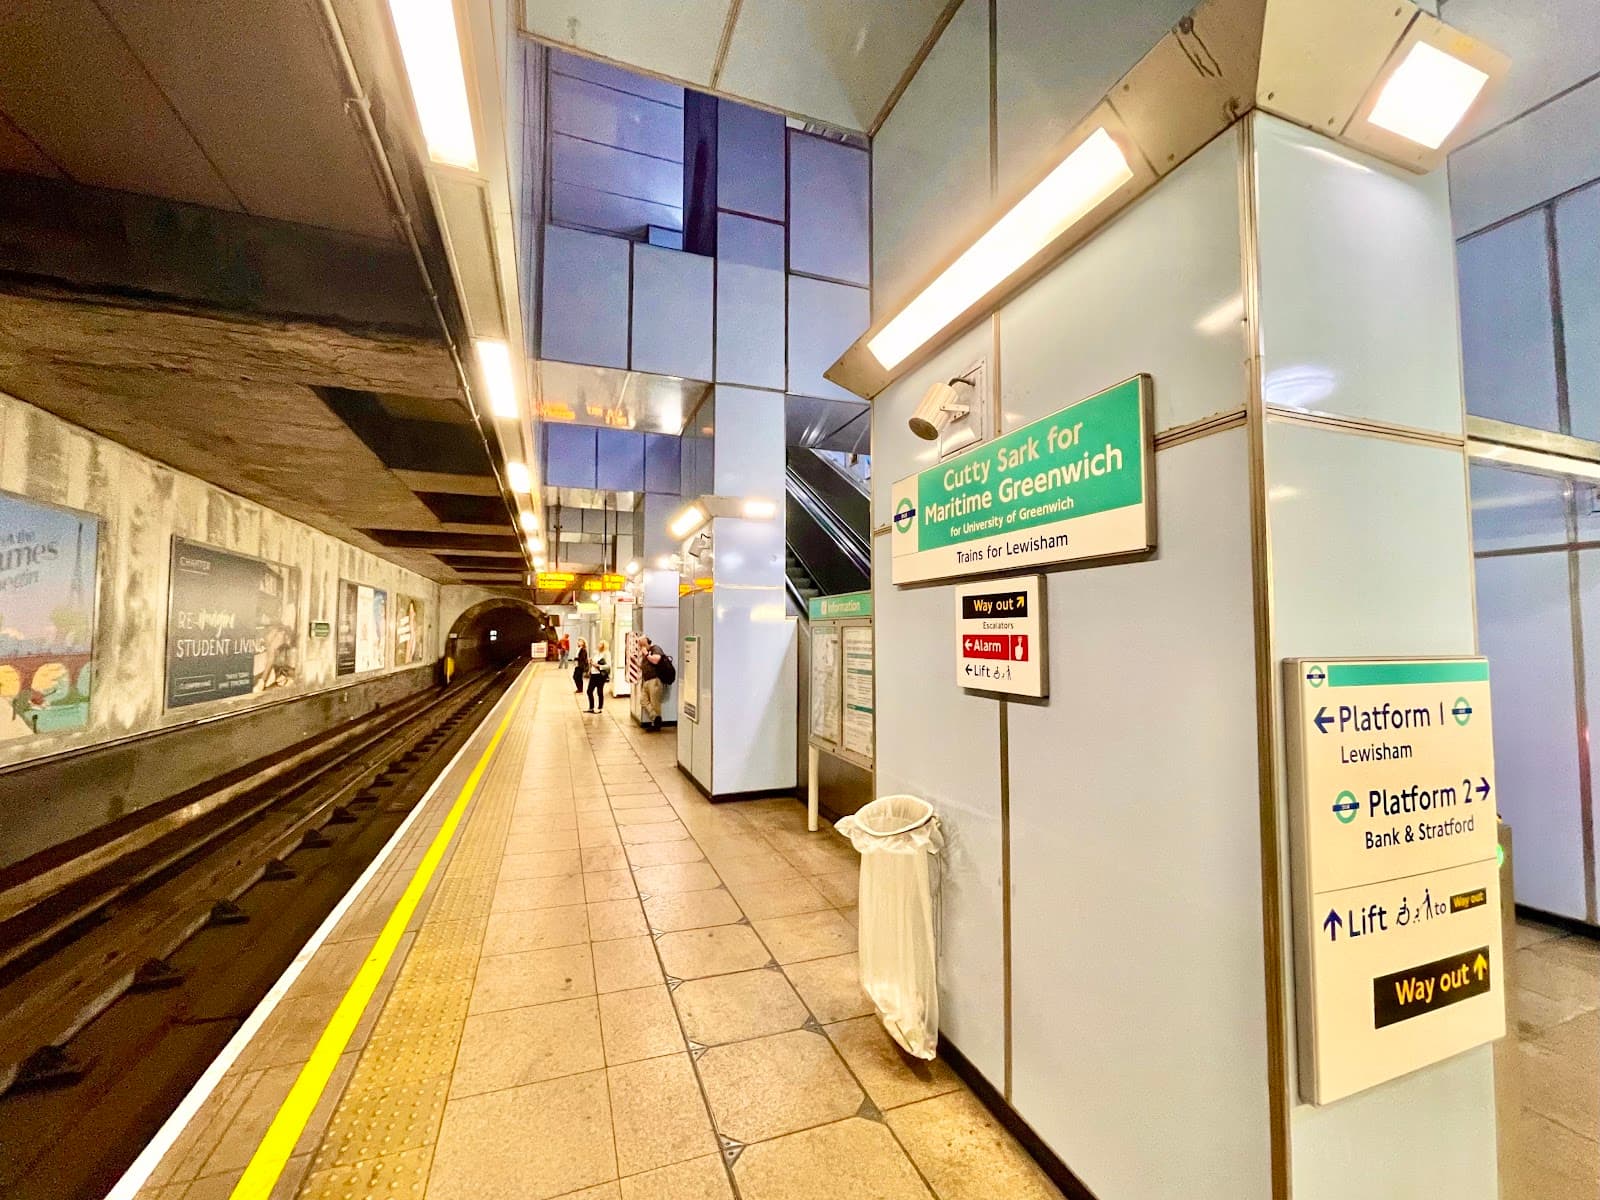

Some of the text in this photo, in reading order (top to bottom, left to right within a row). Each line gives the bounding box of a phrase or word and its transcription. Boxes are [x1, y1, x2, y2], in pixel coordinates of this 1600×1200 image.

[943, 421, 1083, 492] Cutty Sark for
[924, 443, 1123, 526] Maritime Greenwich
[950, 496, 1075, 538] for University of Greenwich
[956, 532, 1069, 565] Trains for Lewisham
[973, 598, 1014, 614] Way out
[983, 621, 1014, 630] Escalators
[175, 637, 267, 658] STUDENT LIVING
[973, 639, 1002, 652] Alarm
[973, 664, 991, 678] Lift
[1338, 701, 1445, 733] Platform 1
[1341, 742, 1413, 764] Lewisham
[1368, 778, 1473, 818] Platform 2
[1365, 814, 1475, 850] Bank & Stratford
[1348, 891, 1485, 938] Lift to Way out
[1394, 963, 1470, 1006] Way out
